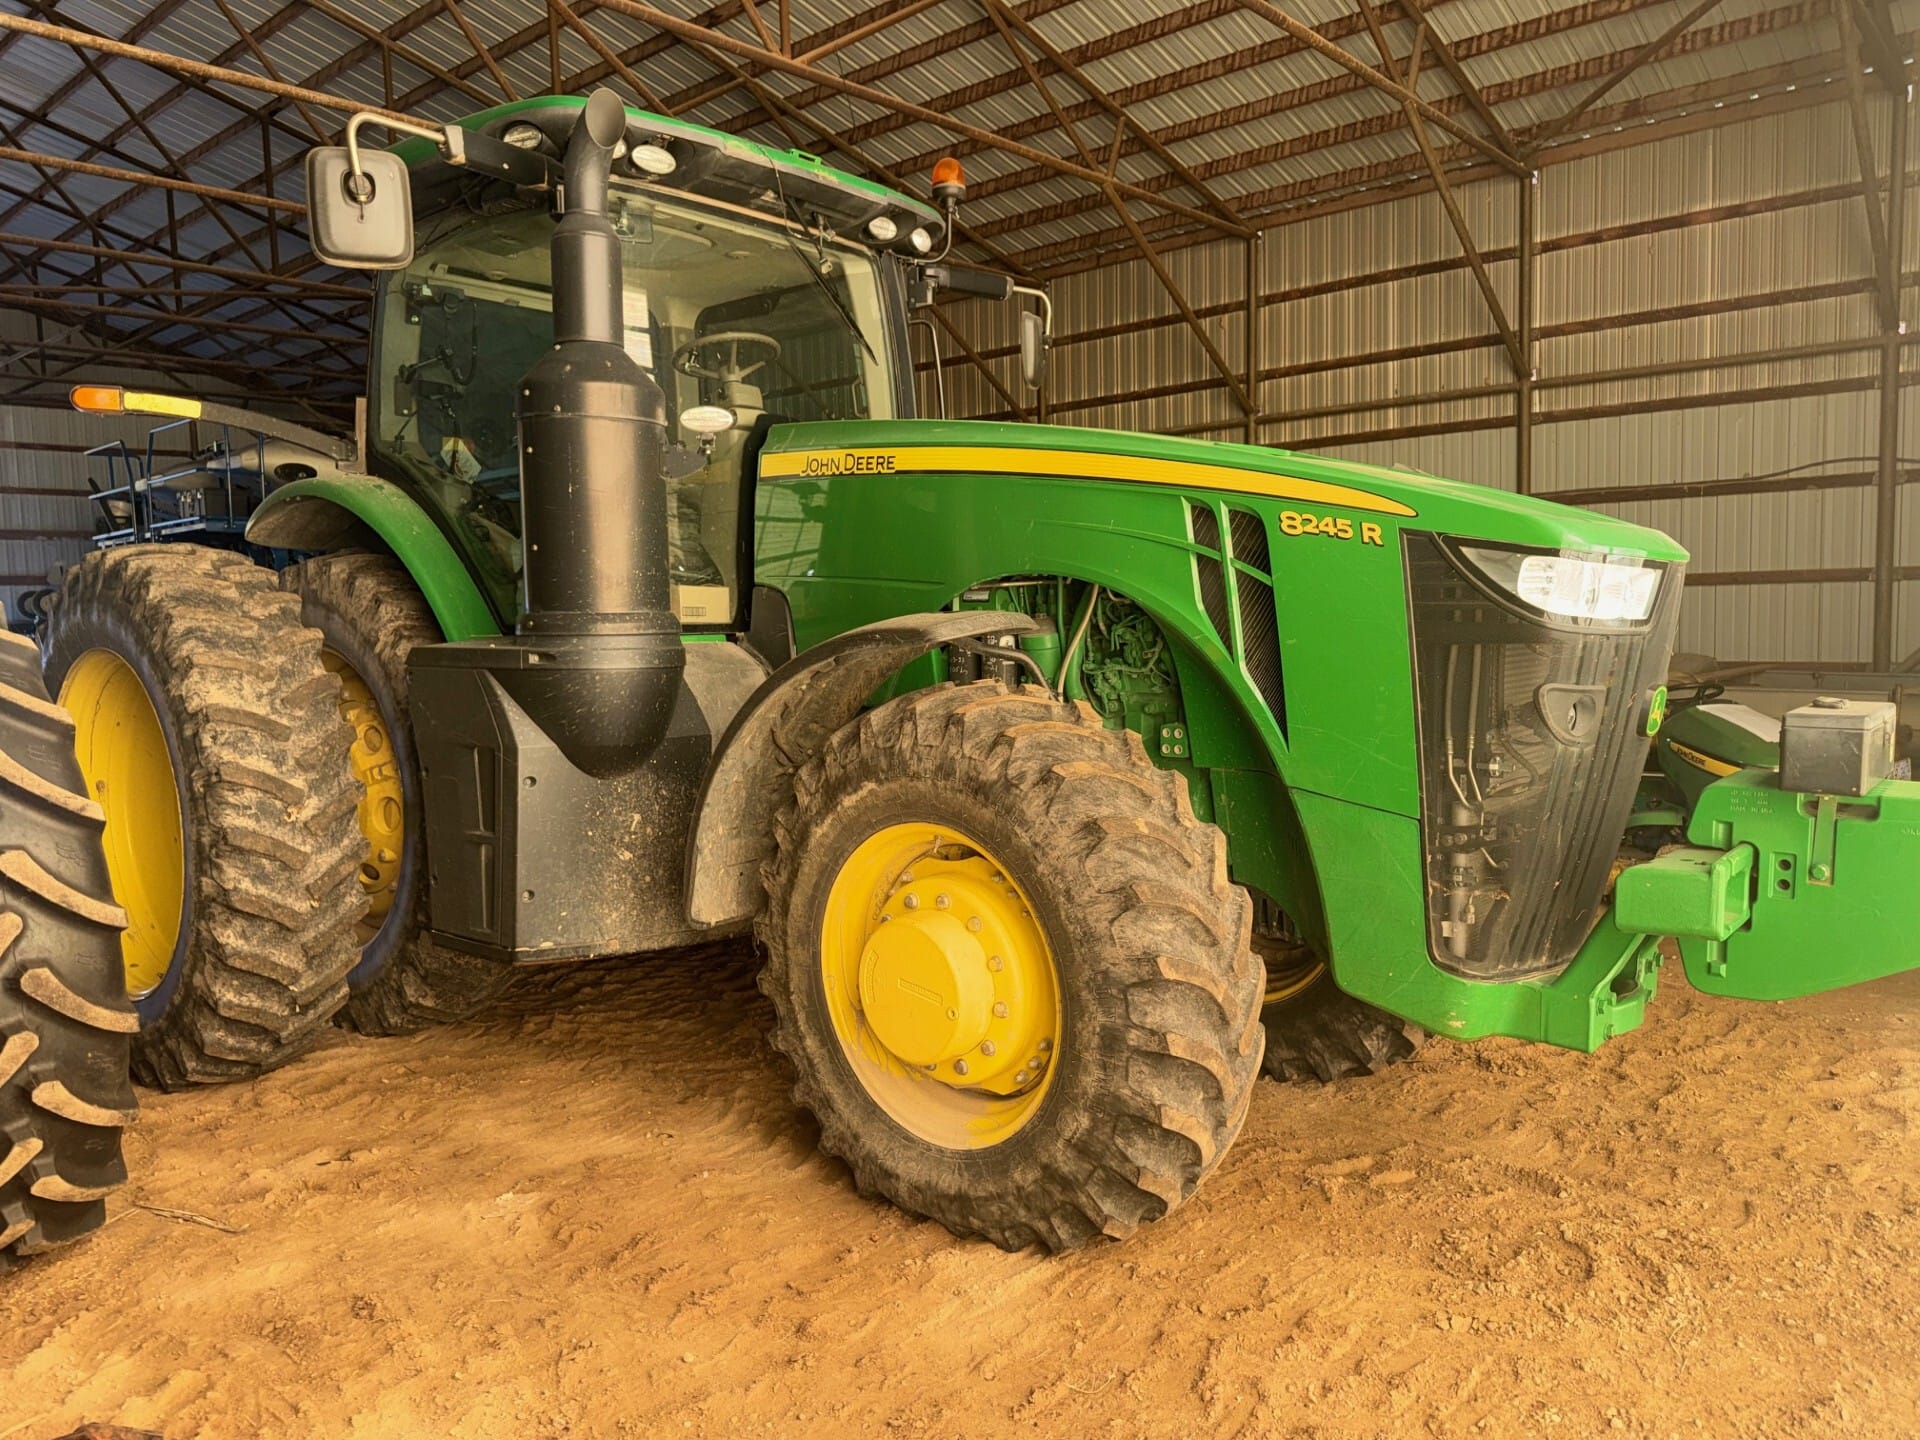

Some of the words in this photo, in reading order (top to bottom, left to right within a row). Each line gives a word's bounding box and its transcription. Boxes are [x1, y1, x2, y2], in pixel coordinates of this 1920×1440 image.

[801, 455, 841, 474] JOHN
[844, 453, 896, 472] DEERE
[1279, 510, 1354, 540] 8245
[1360, 521, 1384, 547] R
